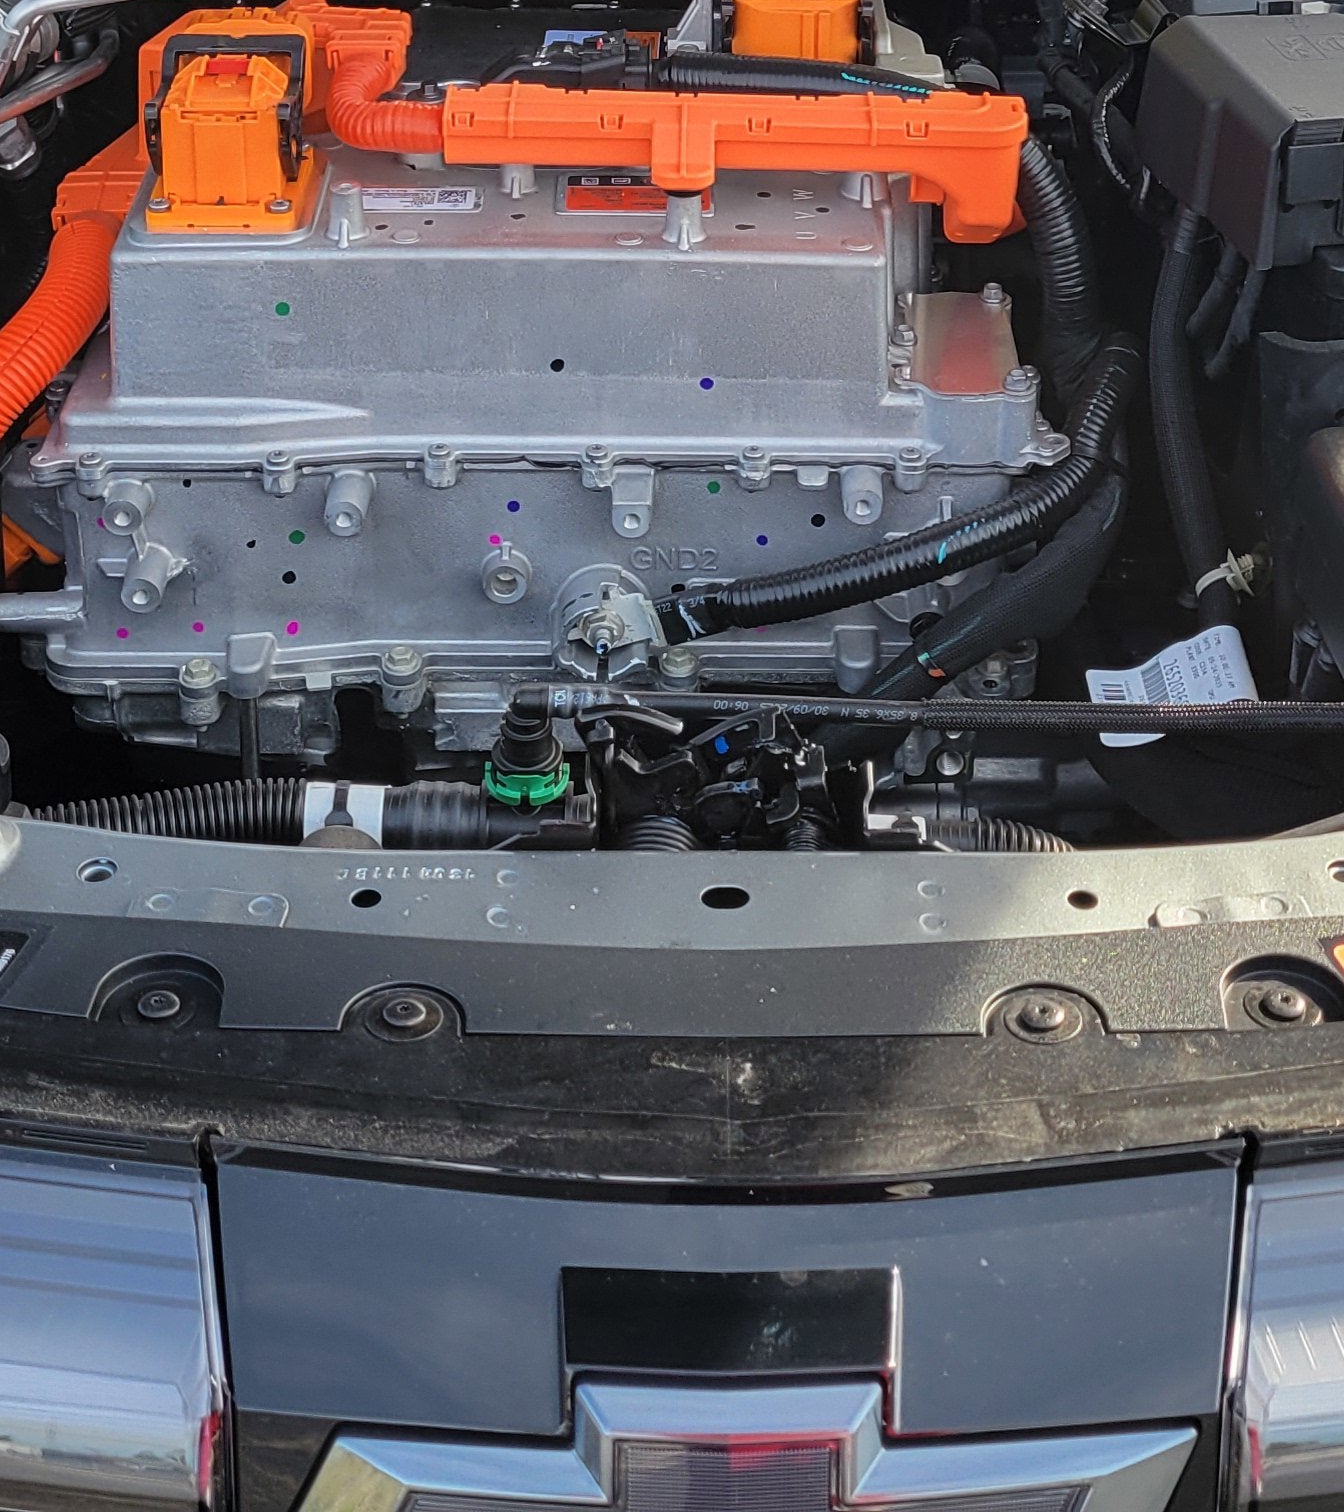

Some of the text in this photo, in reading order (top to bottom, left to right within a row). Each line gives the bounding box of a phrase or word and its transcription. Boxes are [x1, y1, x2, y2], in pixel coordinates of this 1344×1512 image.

[792, 189, 814, 200] W
[793, 211, 816, 220] V
[630, 546, 719, 571] GND2
[712, 699, 750, 711] 06:00
